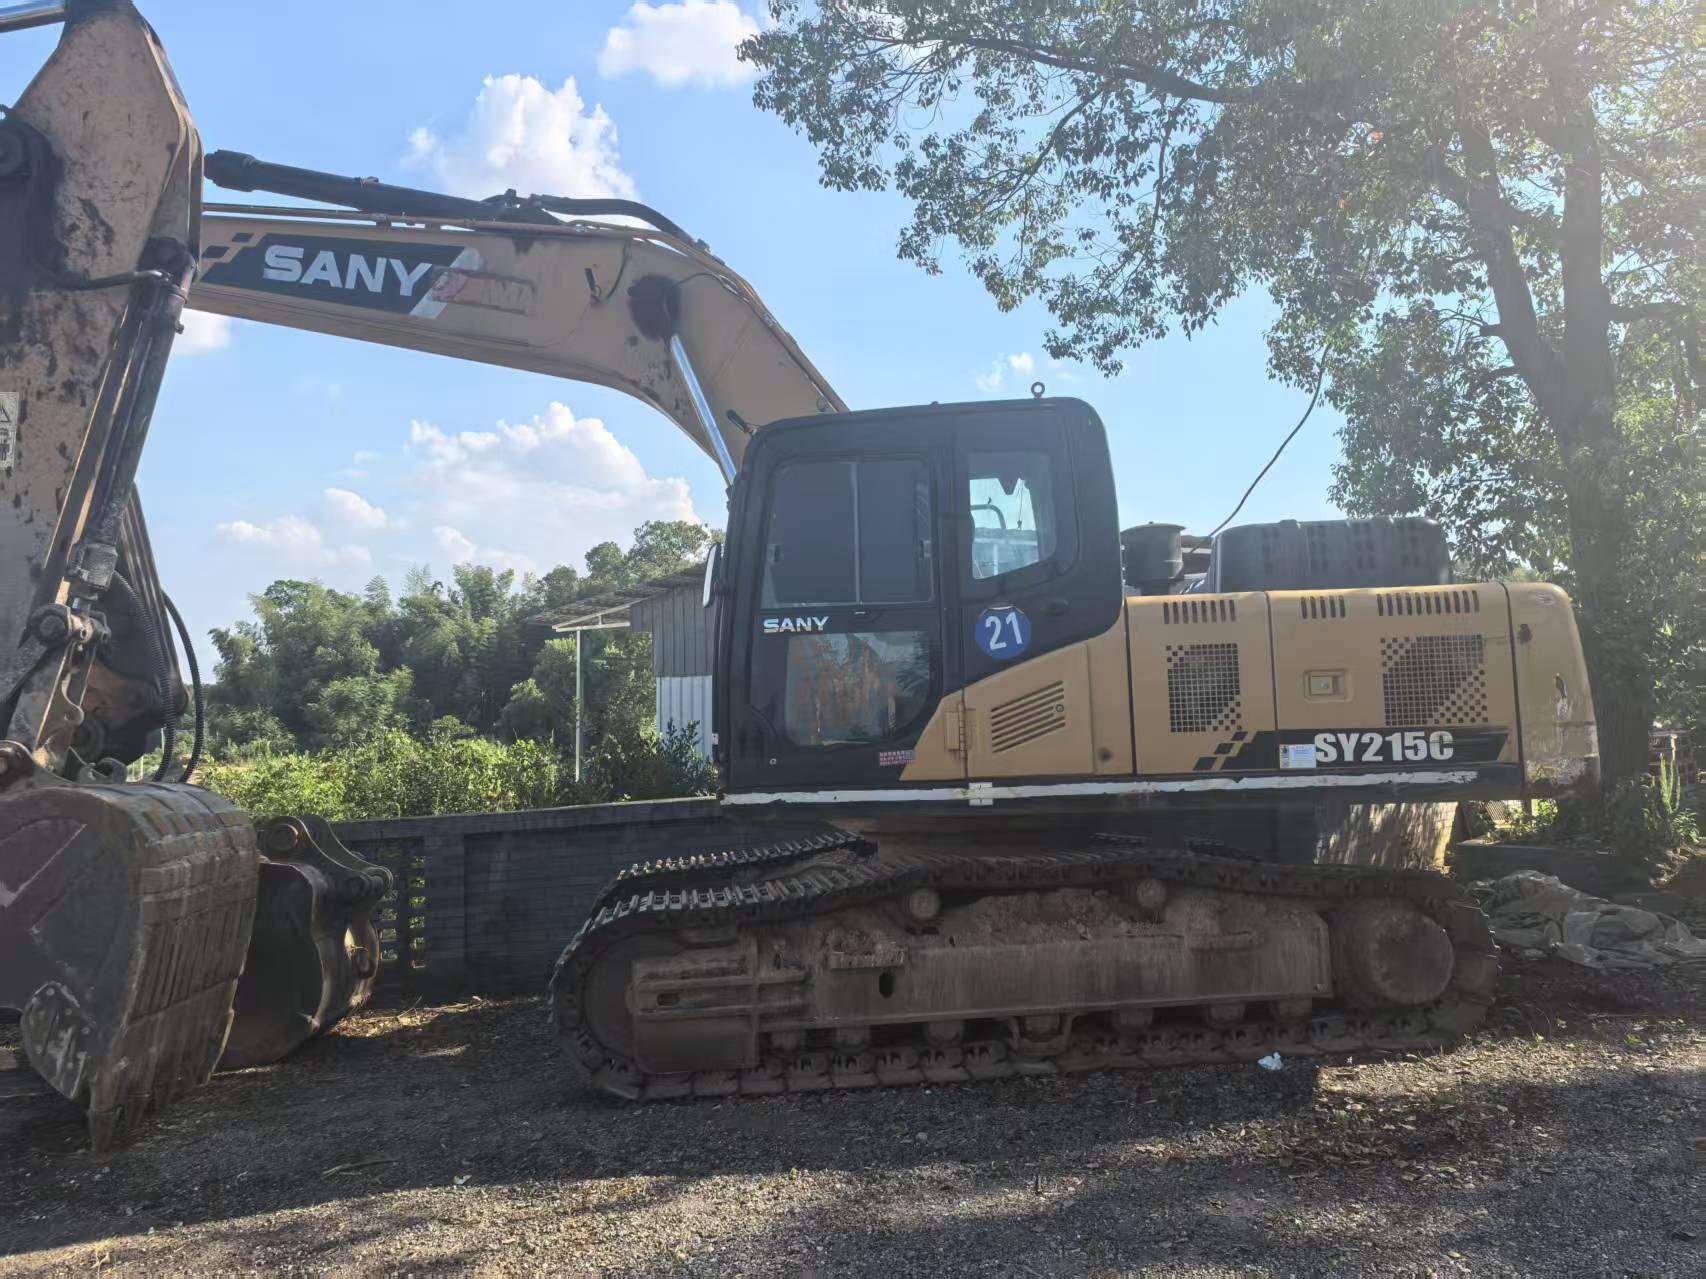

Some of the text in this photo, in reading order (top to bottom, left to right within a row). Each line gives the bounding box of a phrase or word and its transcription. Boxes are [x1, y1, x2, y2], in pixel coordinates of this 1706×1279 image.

[262, 244, 432, 297] SANY
[763, 616, 829, 633] SANY
[985, 612, 1023, 650] 21
[1314, 731, 1454, 762] SY215C
